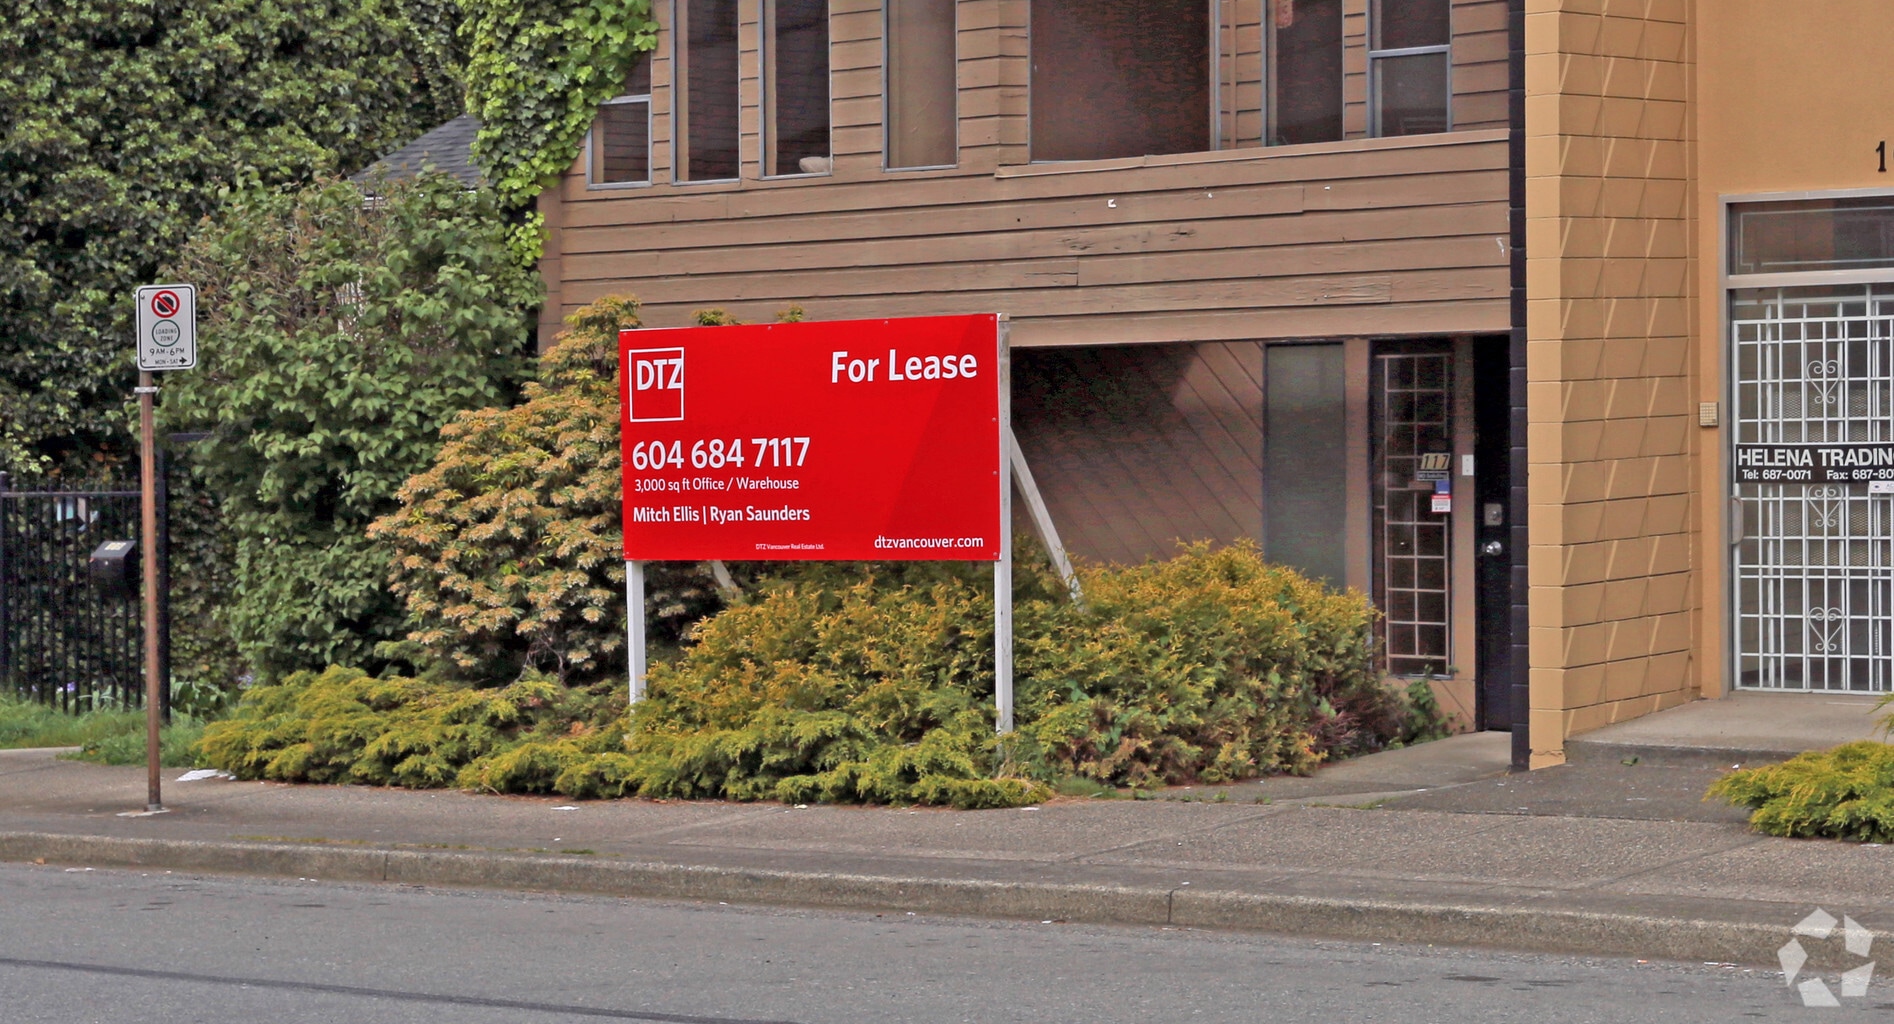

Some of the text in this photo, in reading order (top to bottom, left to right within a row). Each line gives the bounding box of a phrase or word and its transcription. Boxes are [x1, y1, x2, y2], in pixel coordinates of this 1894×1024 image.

[637, 358, 683, 390] DTZ
[831, 349, 977, 383] For Lease
[632, 437, 811, 470] 604 684 7117
[1424, 455, 1449, 468] 117
[1738, 448, 1894, 466] HELENA TRADIN
[1742, 468, 1894, 479] Tel: 687-0071 Fax: 687-80
[635, 476, 799, 493] 3,000 sq ft Office / Warehouse
[633, 506, 670, 523] Mitch
[673, 505, 700, 522] Ellis
[710, 505, 743, 525] Ryan
[746, 504, 811, 522] Saunders
[874, 535, 984, 549] dtzvancouver.com
